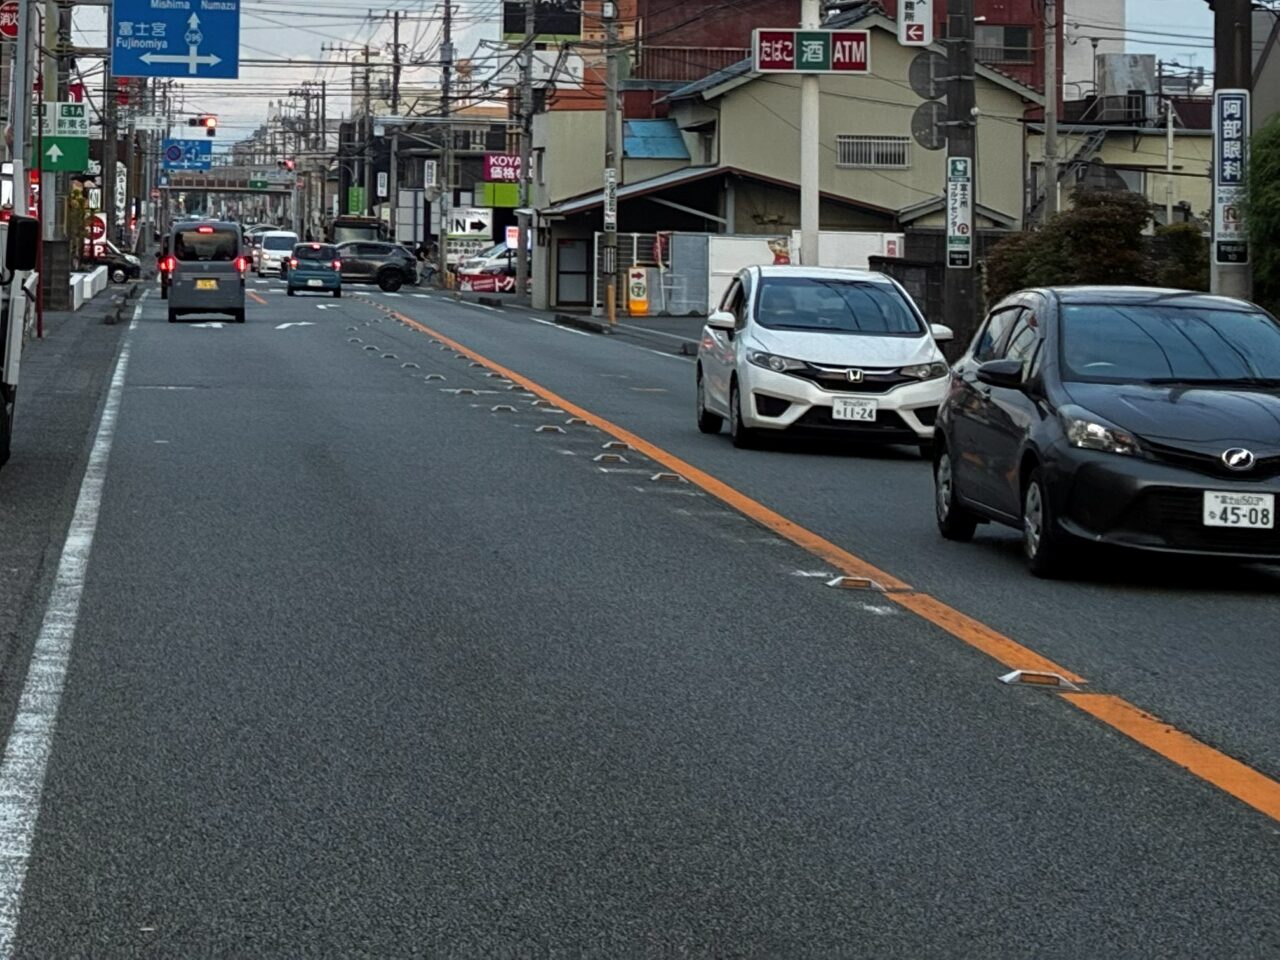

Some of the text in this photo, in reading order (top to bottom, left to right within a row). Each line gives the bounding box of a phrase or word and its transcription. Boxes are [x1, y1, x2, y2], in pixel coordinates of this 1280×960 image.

[201, 0, 236, 10] Numazu
[0, 13, 19, 26] 消火
[118, 21, 167, 37] 富士宮
[116, 37, 168, 50] Fujinomiya
[760, 40, 865, 62] たばこ 酒 ATM
[62, 106, 84, 116] E1A
[1223, 100, 1242, 180] 阿部眼科
[843, 407, 874, 420] 11-24
[1219, 506, 1270, 526] 45-08
